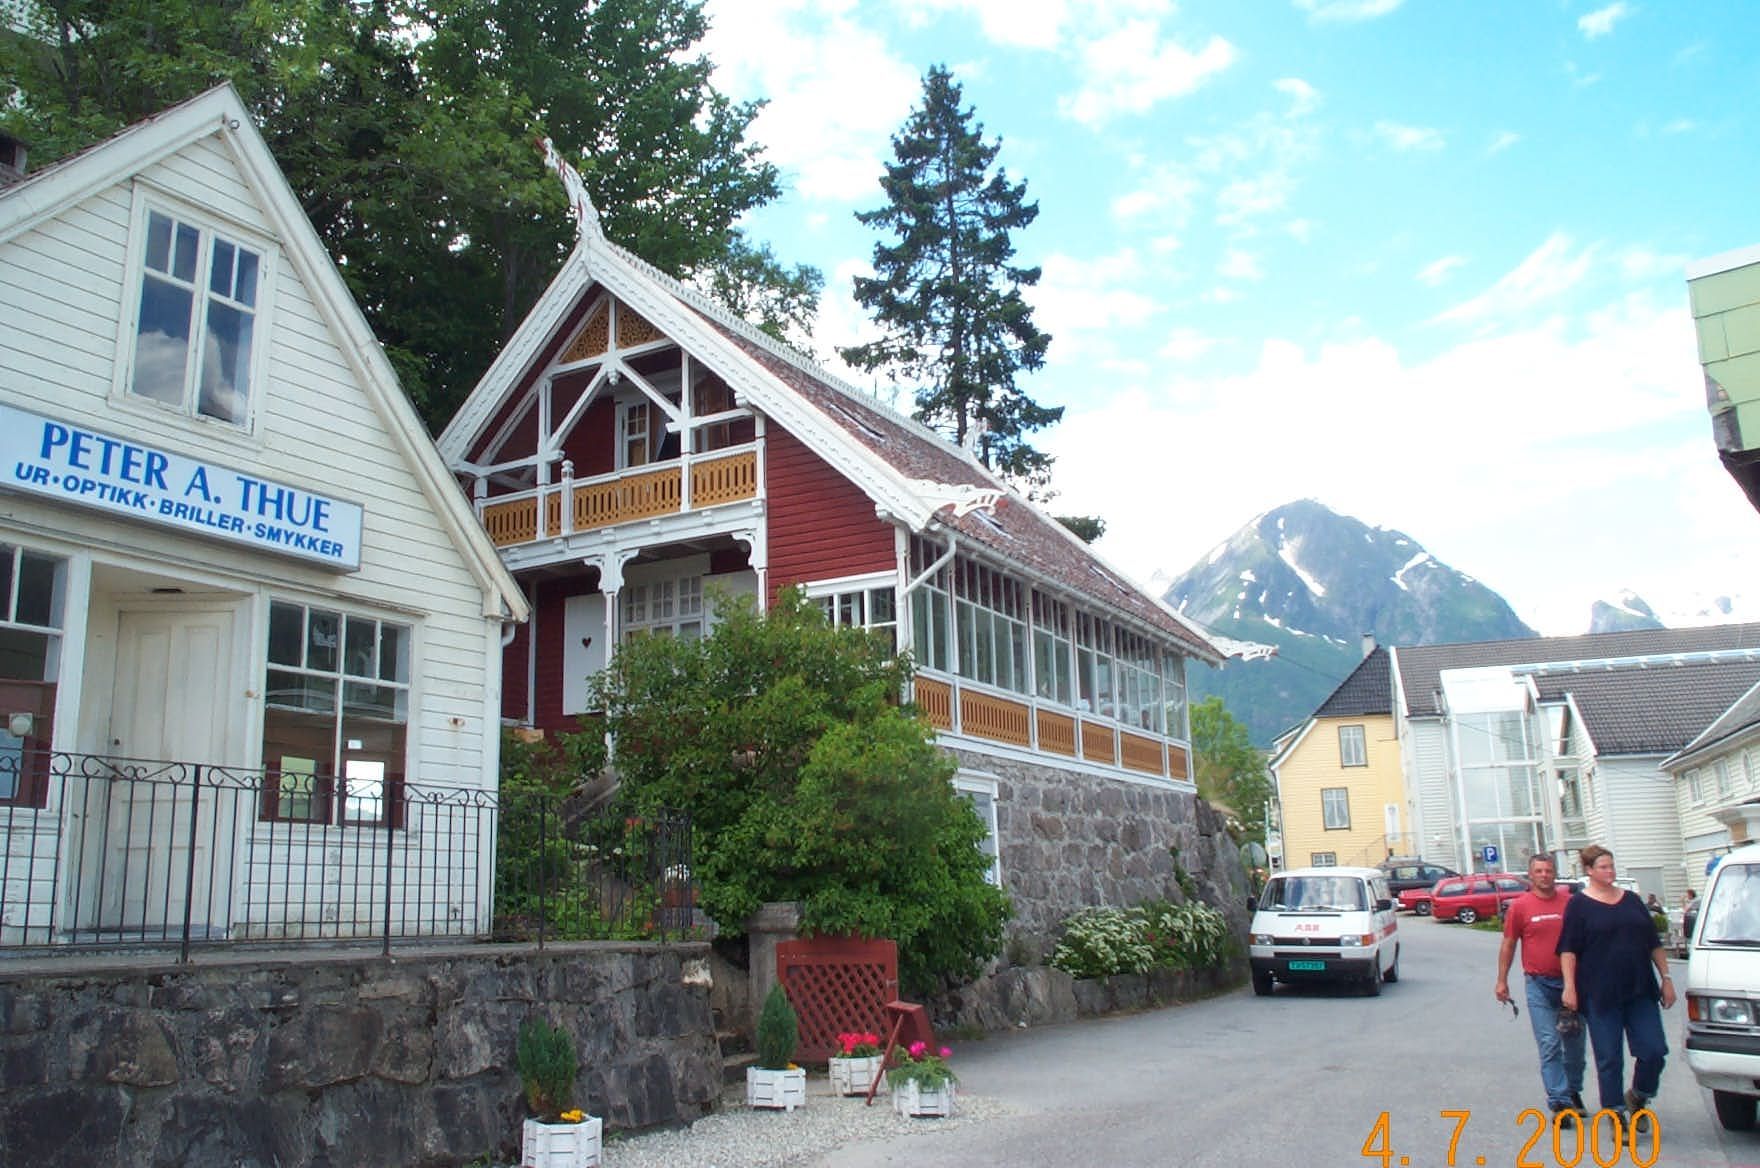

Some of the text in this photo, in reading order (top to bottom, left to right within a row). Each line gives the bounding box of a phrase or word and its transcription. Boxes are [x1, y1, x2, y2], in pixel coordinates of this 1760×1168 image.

[40, 421, 331, 533] PETER A. THUE
[1486, 847, 1496, 861] P
